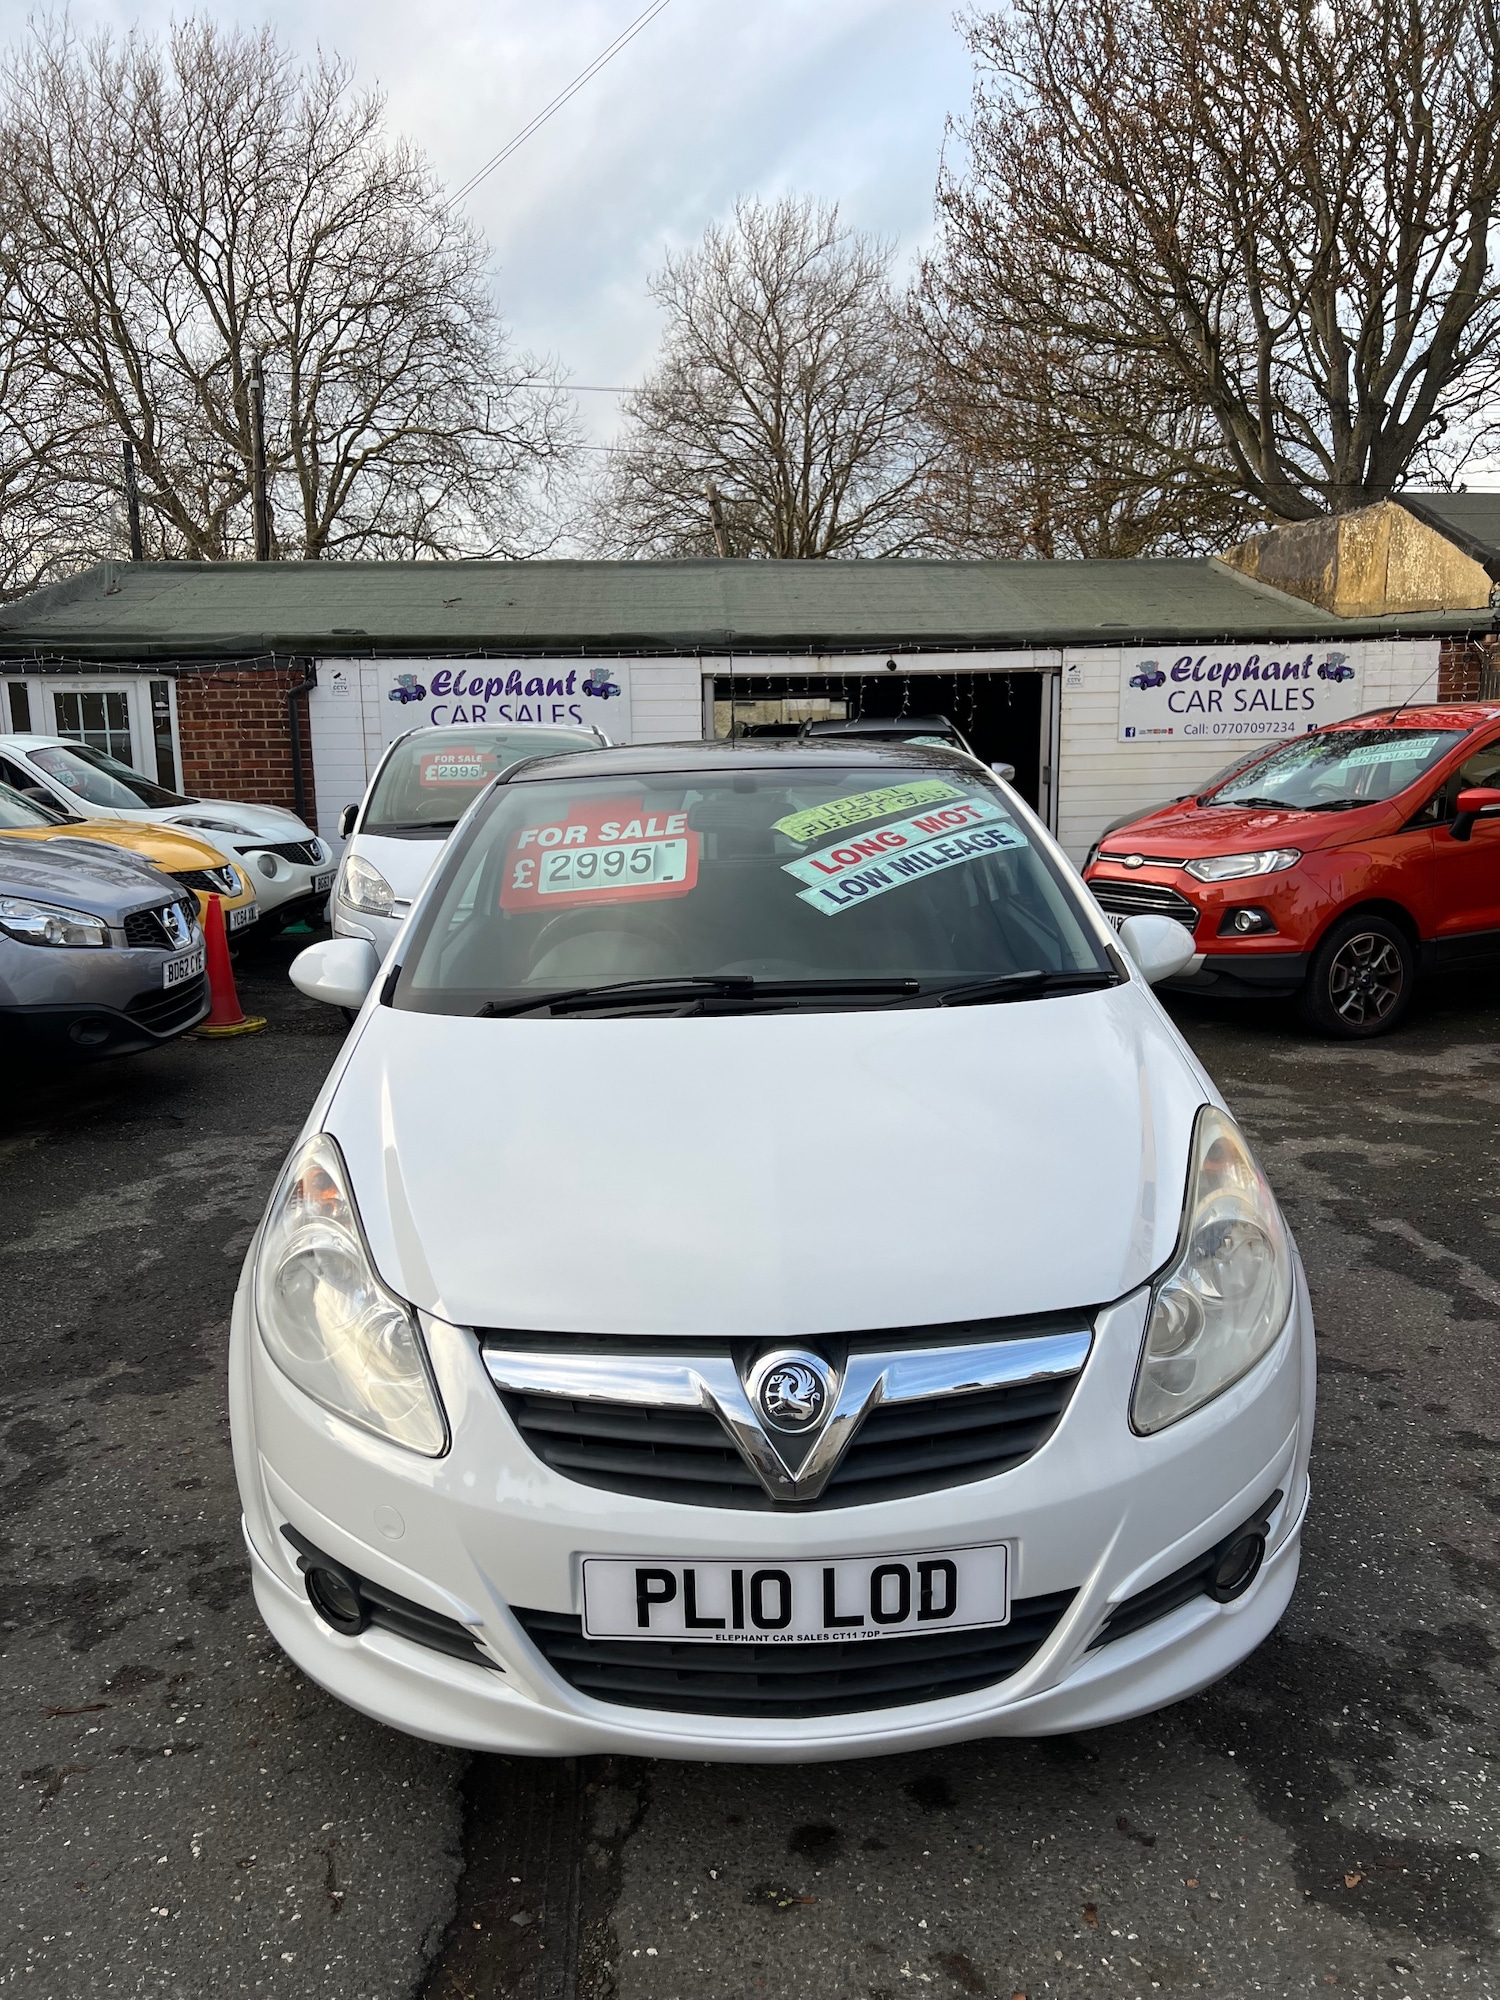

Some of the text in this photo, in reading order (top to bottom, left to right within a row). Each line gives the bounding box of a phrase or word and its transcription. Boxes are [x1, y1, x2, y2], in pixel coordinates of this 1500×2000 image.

[430, 669, 577, 704] Elephant
[1170, 653, 1314, 688] Elephant
[430, 703, 583, 726] CAR SALES
[1168, 687, 1315, 714] CAR SALES
[1183, 723, 1209, 736] Call:
[1212, 721, 1296, 735] 07707097234
[434, 754, 483, 763] FOR SALE
[439, 766, 479, 778] 2995
[796, 787, 961, 837] FIRST CAR
[814, 788, 913, 818] IDEAL
[516, 812, 688, 850] FOR SALE
[809, 804, 985, 875] LONG MOT
[511, 846, 653, 890] £ 2995
[819, 829, 1016, 906] LOW MILEAGE
[168, 951, 202, 983] BD62 CYE
[635, 1559, 958, 1631] PL10 LOD
[715, 1630, 881, 1642] ELEPHANT CAR SALES CT11 7DP
